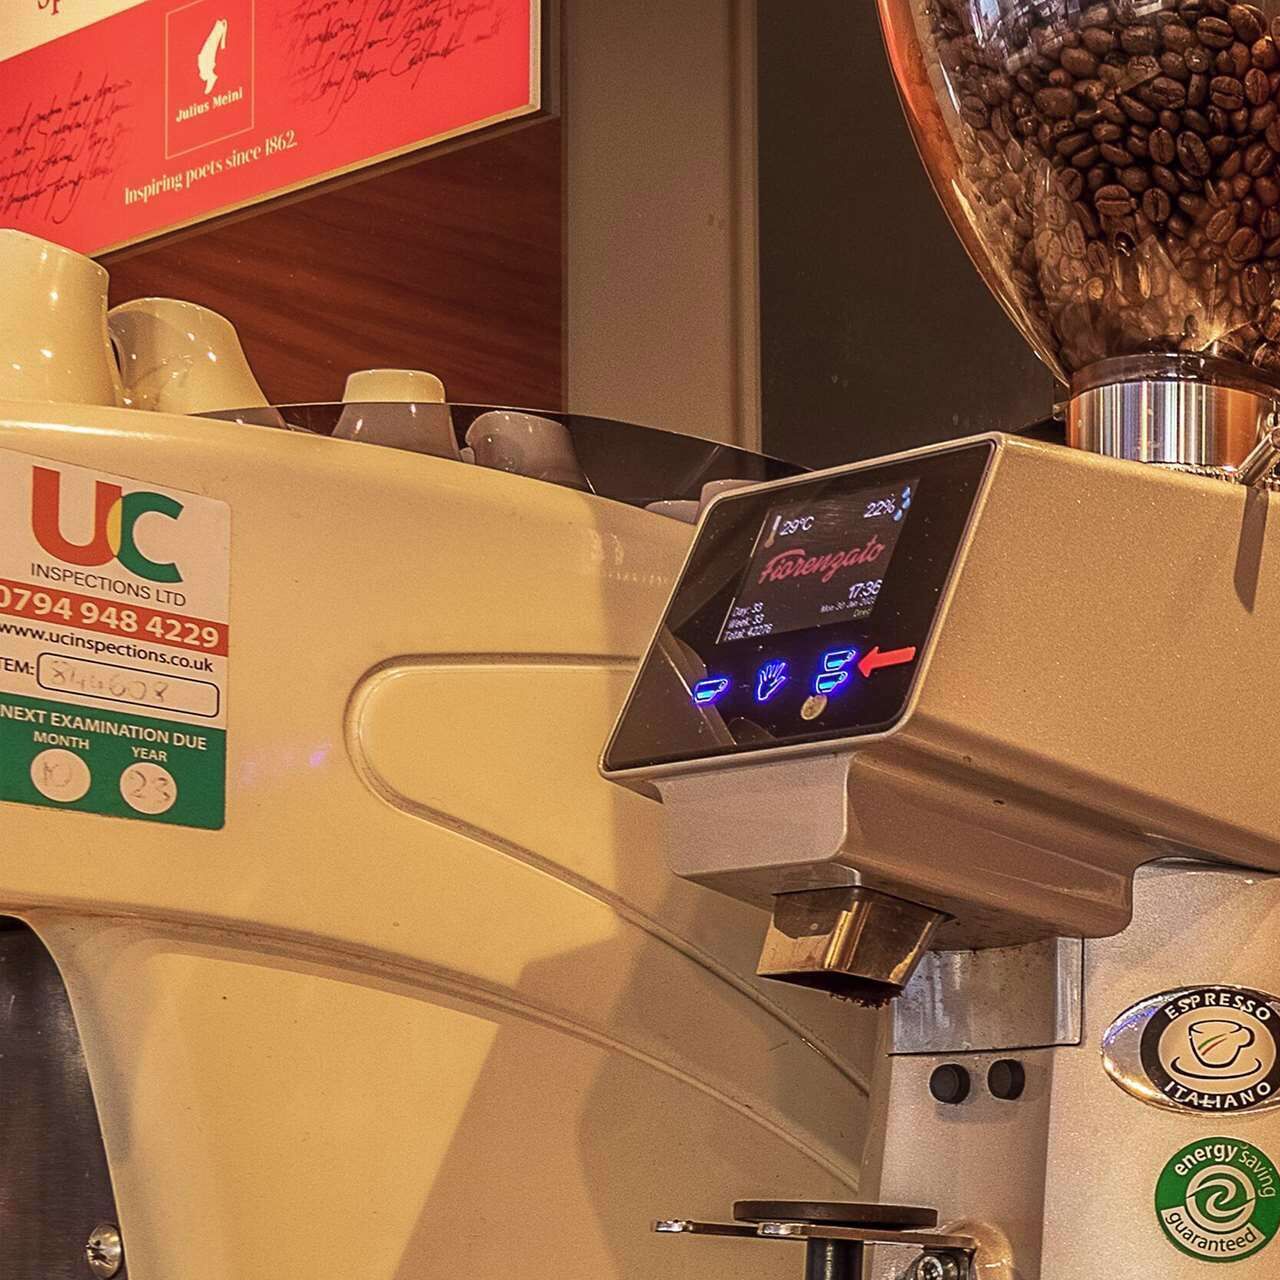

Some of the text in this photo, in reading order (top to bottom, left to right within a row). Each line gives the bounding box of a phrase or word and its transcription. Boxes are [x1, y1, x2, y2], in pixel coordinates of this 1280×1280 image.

[176, 87, 244, 123] Julius Meinl
[124, 169, 183, 206] Inspiring
[186, 161, 223, 190] poets
[225, 145, 262, 170] since
[32, 465, 185, 584] UC
[863, 498, 896, 518] 22%
[759, 535, 885, 583] Fiorenzato
[31, 562, 186, 607] INSPECTIONS LTD
[848, 579, 884, 600] 17:36
[0, 584, 220, 648] 0794 948 4229
[0, 623, 213, 673] www.ucinspections.co.uk
[0, 704, 208, 751] NEXT EXAMINATION DUE
[33, 730, 90, 750] MONTH
[131, 746, 168, 763] YEAR
[1165, 992, 1272, 1021] ESPRESSO
[1164, 1081, 1272, 1110] ITALIANO
[1174, 1143, 1277, 1199] energy saving
[1165, 1210, 1258, 1252] guaranteed
